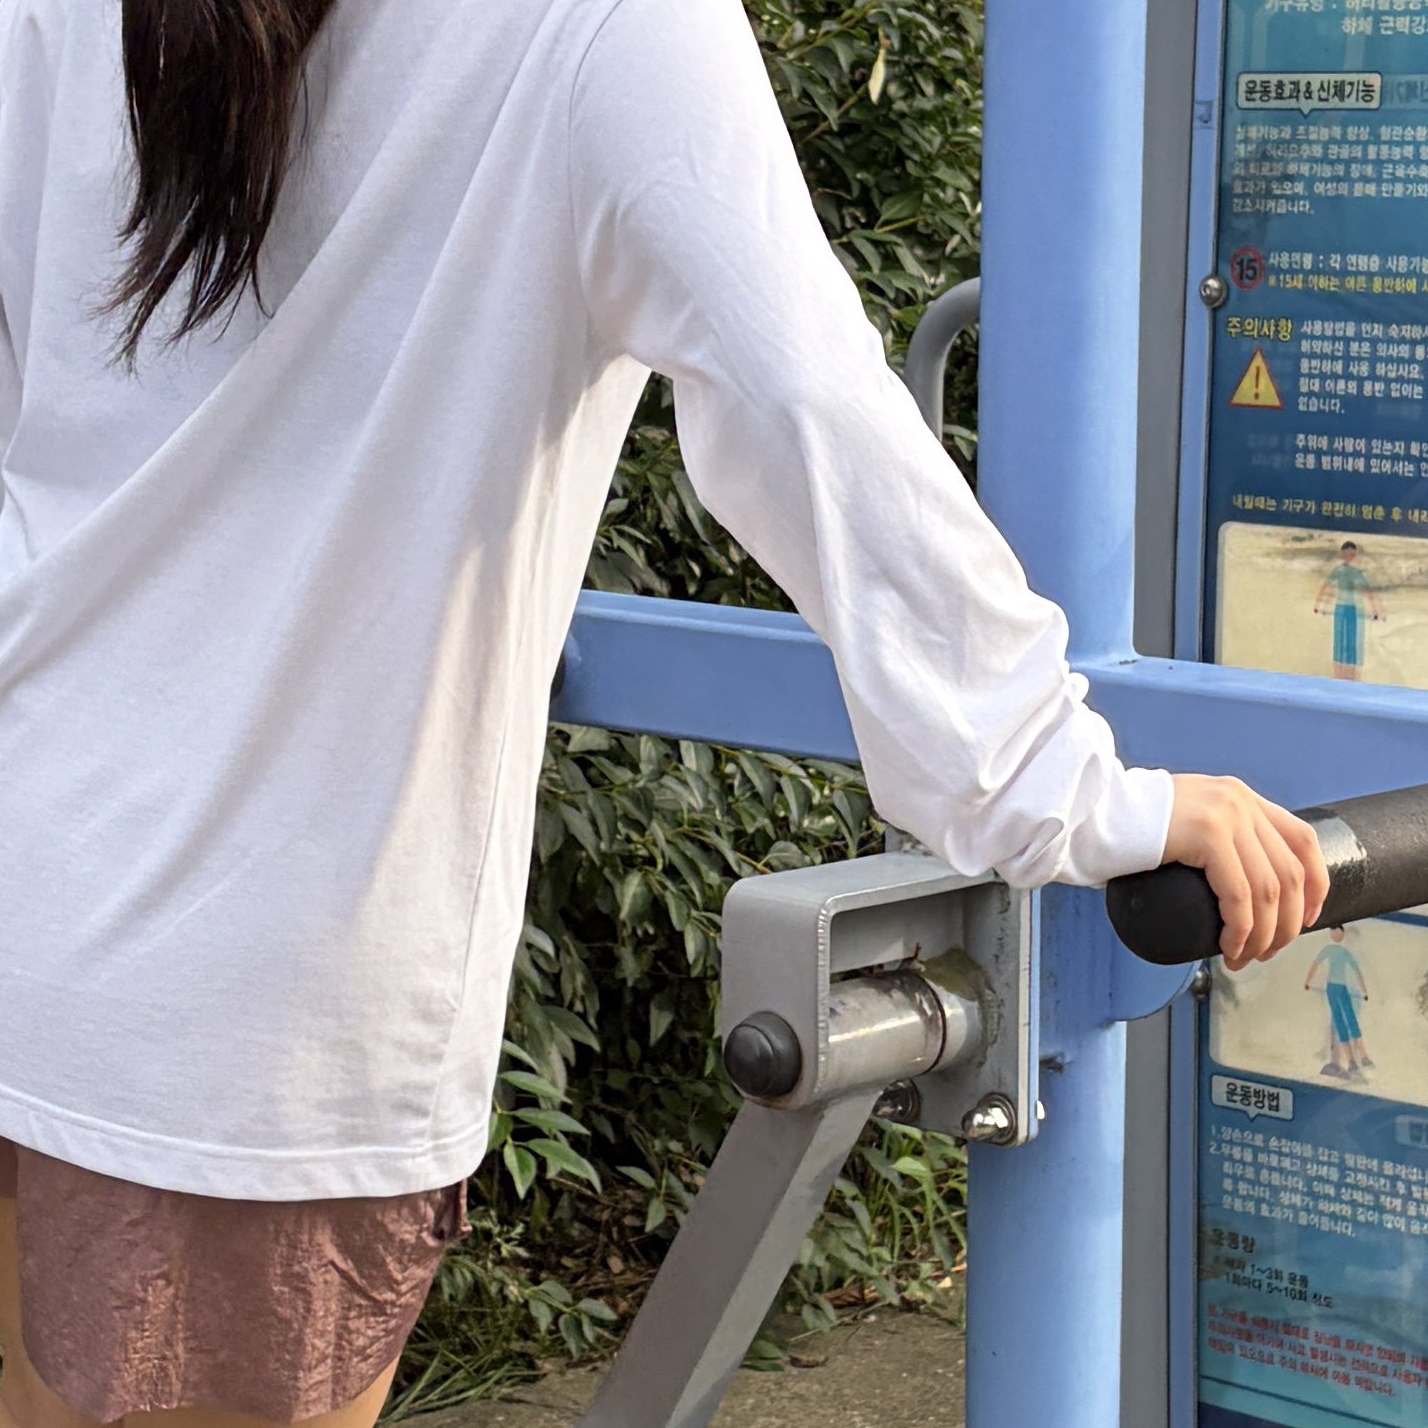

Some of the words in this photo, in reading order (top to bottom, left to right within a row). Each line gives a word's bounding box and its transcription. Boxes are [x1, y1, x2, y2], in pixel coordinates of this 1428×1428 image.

[1225, 316, 1293, 342] 주의사항
[1348, 360, 1370, 377] 사용
[1225, 1081, 1282, 1114] 운동방법
